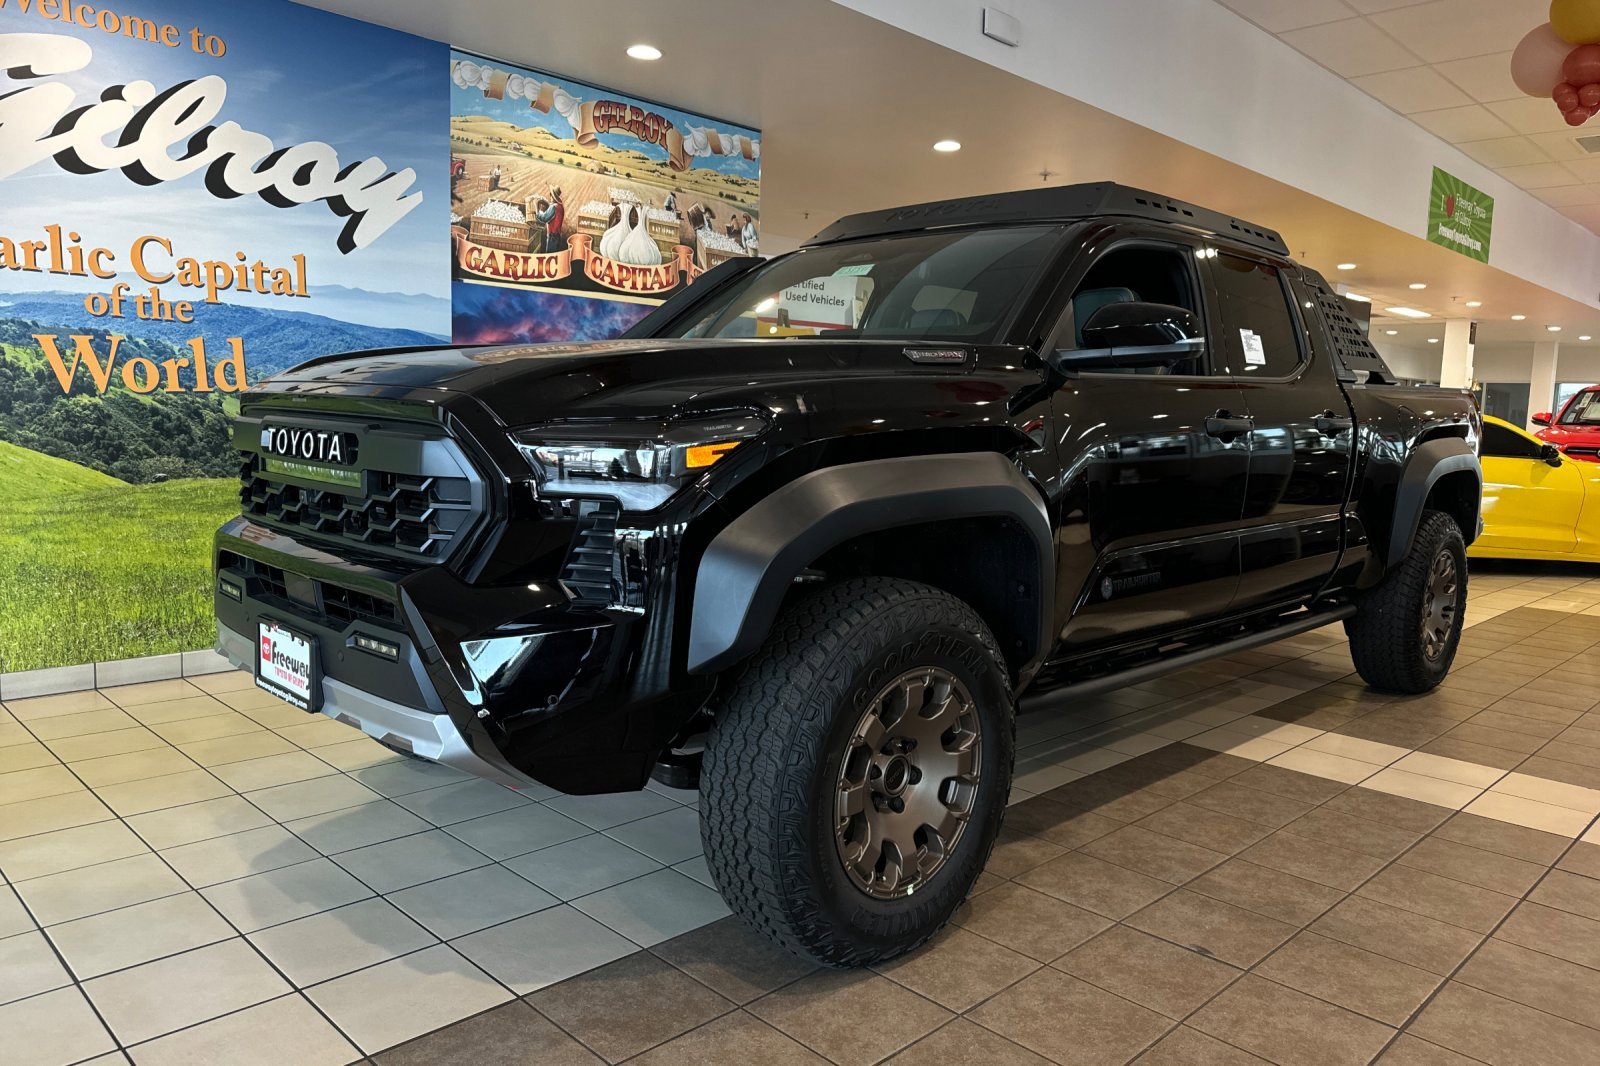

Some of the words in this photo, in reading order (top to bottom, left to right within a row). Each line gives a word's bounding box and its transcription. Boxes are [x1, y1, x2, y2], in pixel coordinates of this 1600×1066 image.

[189, 27, 227, 58] to
[0, 33, 423, 254] Gilroy
[592, 99, 674, 150] GILROY
[130, 235, 311, 304] Capital
[465, 246, 559, 281] GARLIC
[590, 256, 675, 291] CAPITAL
[84, 283, 130, 318] of
[135, 286, 194, 323] the
[785, 291, 808, 302] Used
[810, 293, 845, 307] Vehicles
[32, 334, 250, 394] World
[267, 427, 342, 462] TOYOTA
[271, 640, 310, 691] freeway
